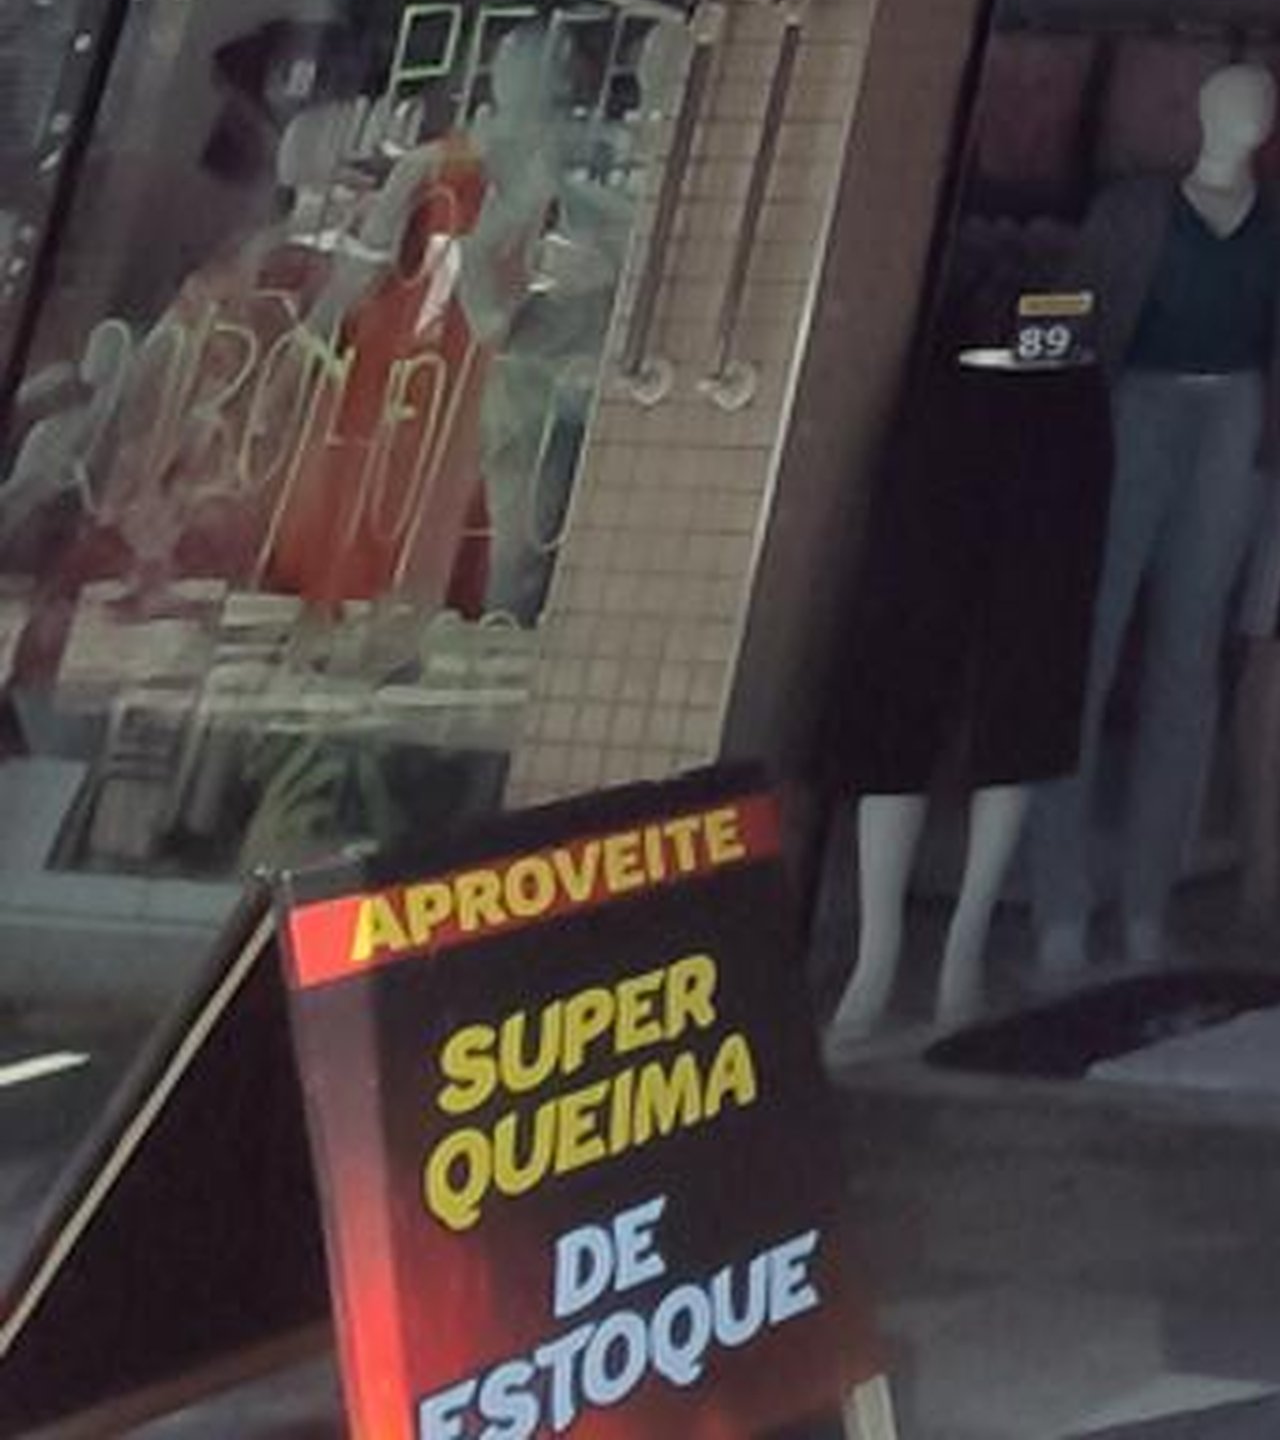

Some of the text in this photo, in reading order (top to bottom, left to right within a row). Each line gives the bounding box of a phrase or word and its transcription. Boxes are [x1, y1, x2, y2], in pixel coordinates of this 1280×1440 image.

[1018, 324, 1072, 360] 89
[350, 807, 747, 962] APROVEITE
[437, 953, 717, 1113] SUPER
[424, 1033, 757, 1231] QUEIMA
[419, 1228, 821, 1440] ESTOQUE
[553, 1194, 669, 1318] DE
